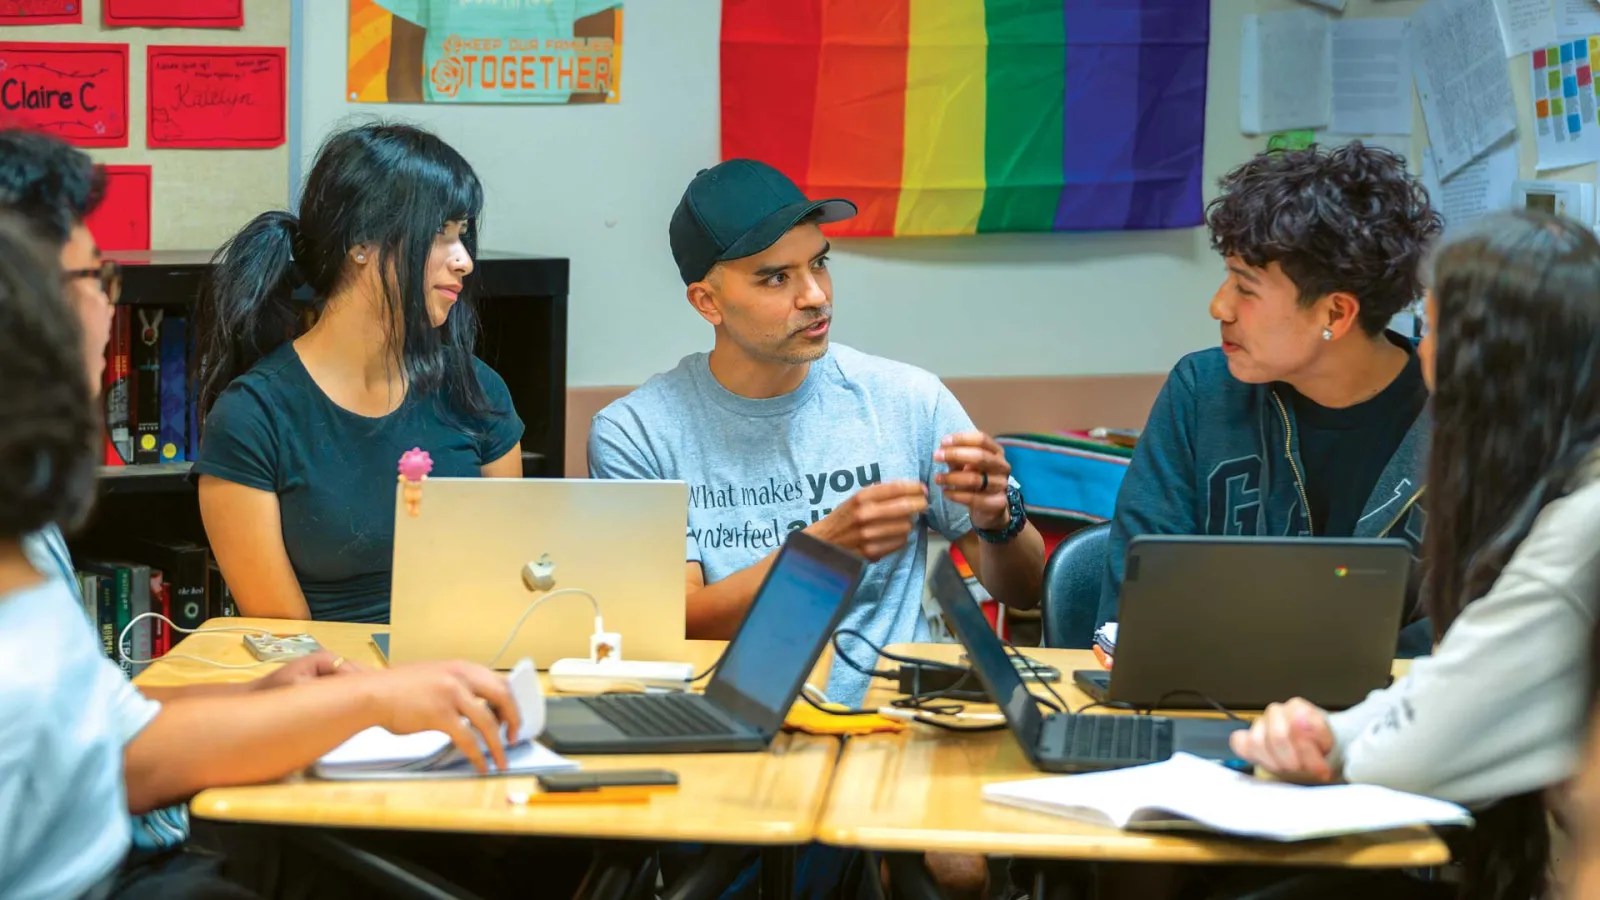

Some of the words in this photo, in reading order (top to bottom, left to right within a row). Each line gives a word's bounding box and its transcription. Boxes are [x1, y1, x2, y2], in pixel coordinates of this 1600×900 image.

[461, 38, 502, 51] KEEP
[508, 38, 539, 52] OUR
[462, 55, 610, 90] TOGETHER
[1, 78, 74, 110] Claire
[79, 81, 98, 112] C
[742, 477, 803, 506] makes
[805, 462, 882, 505] you
